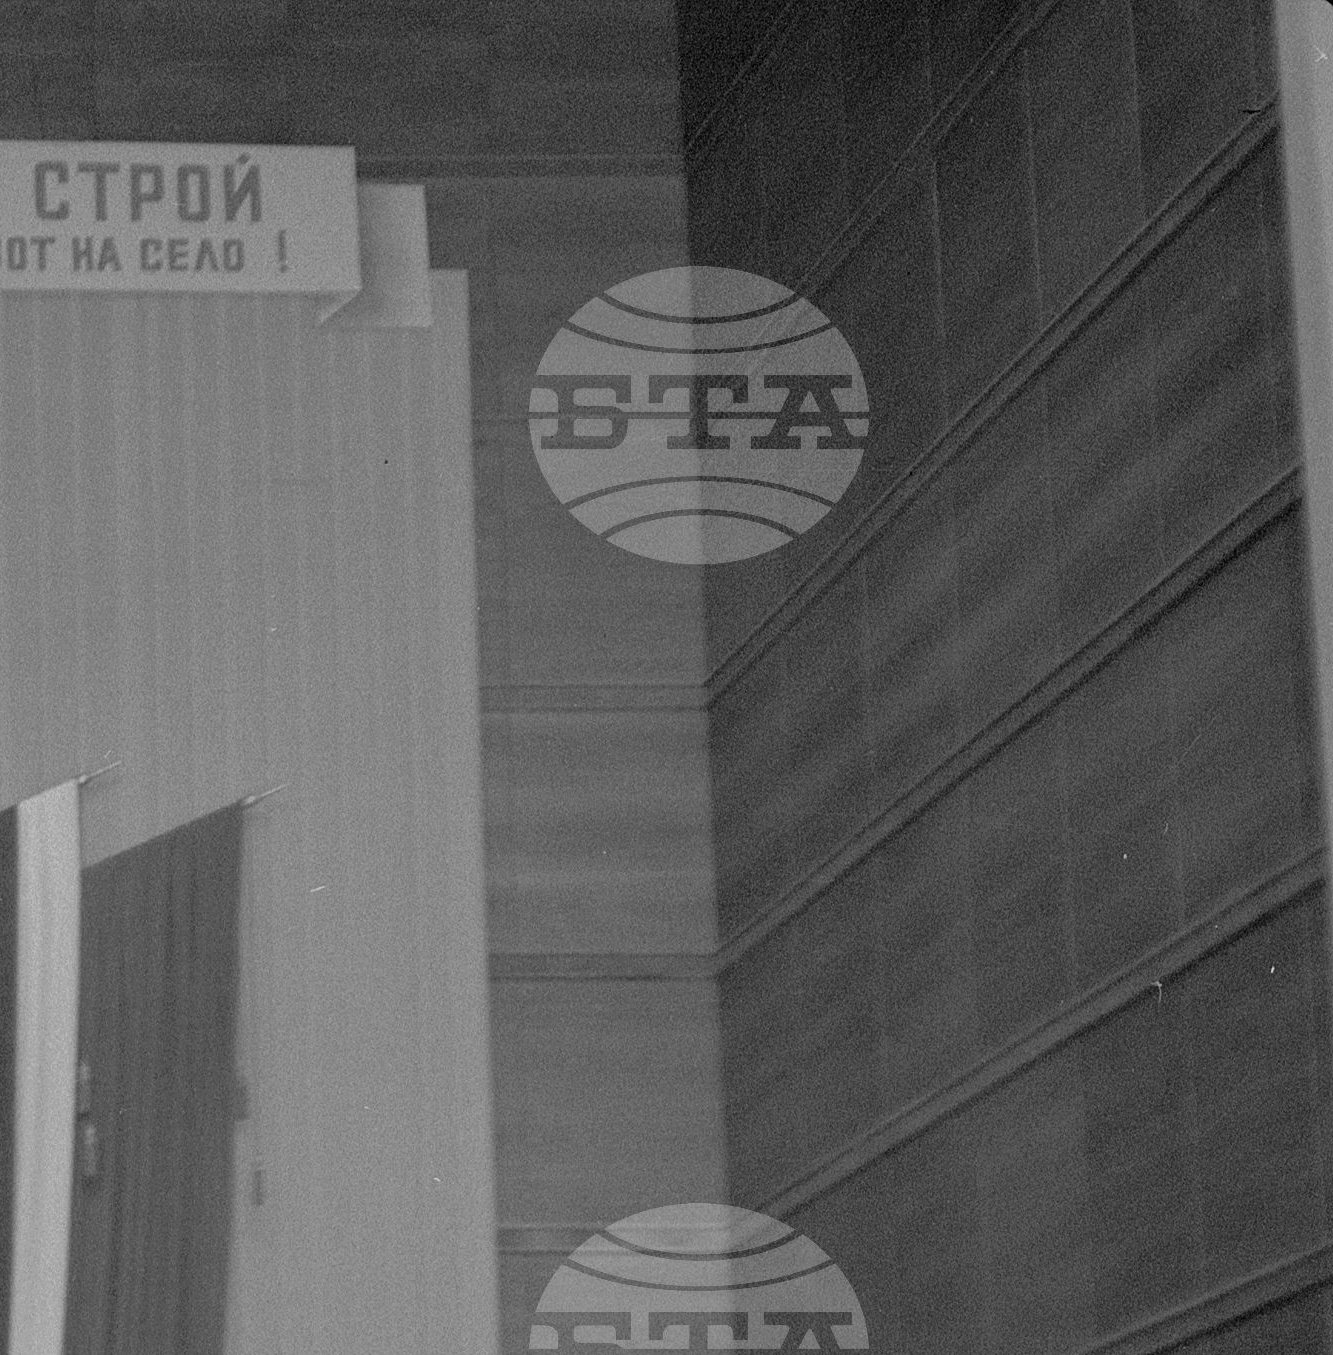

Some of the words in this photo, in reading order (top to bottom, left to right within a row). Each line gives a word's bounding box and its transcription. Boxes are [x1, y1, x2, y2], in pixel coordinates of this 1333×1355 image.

[34, 152, 262, 223] СТРОЙ
[72, 237, 122, 272] НА
[140, 238, 244, 272] СЕЛО
